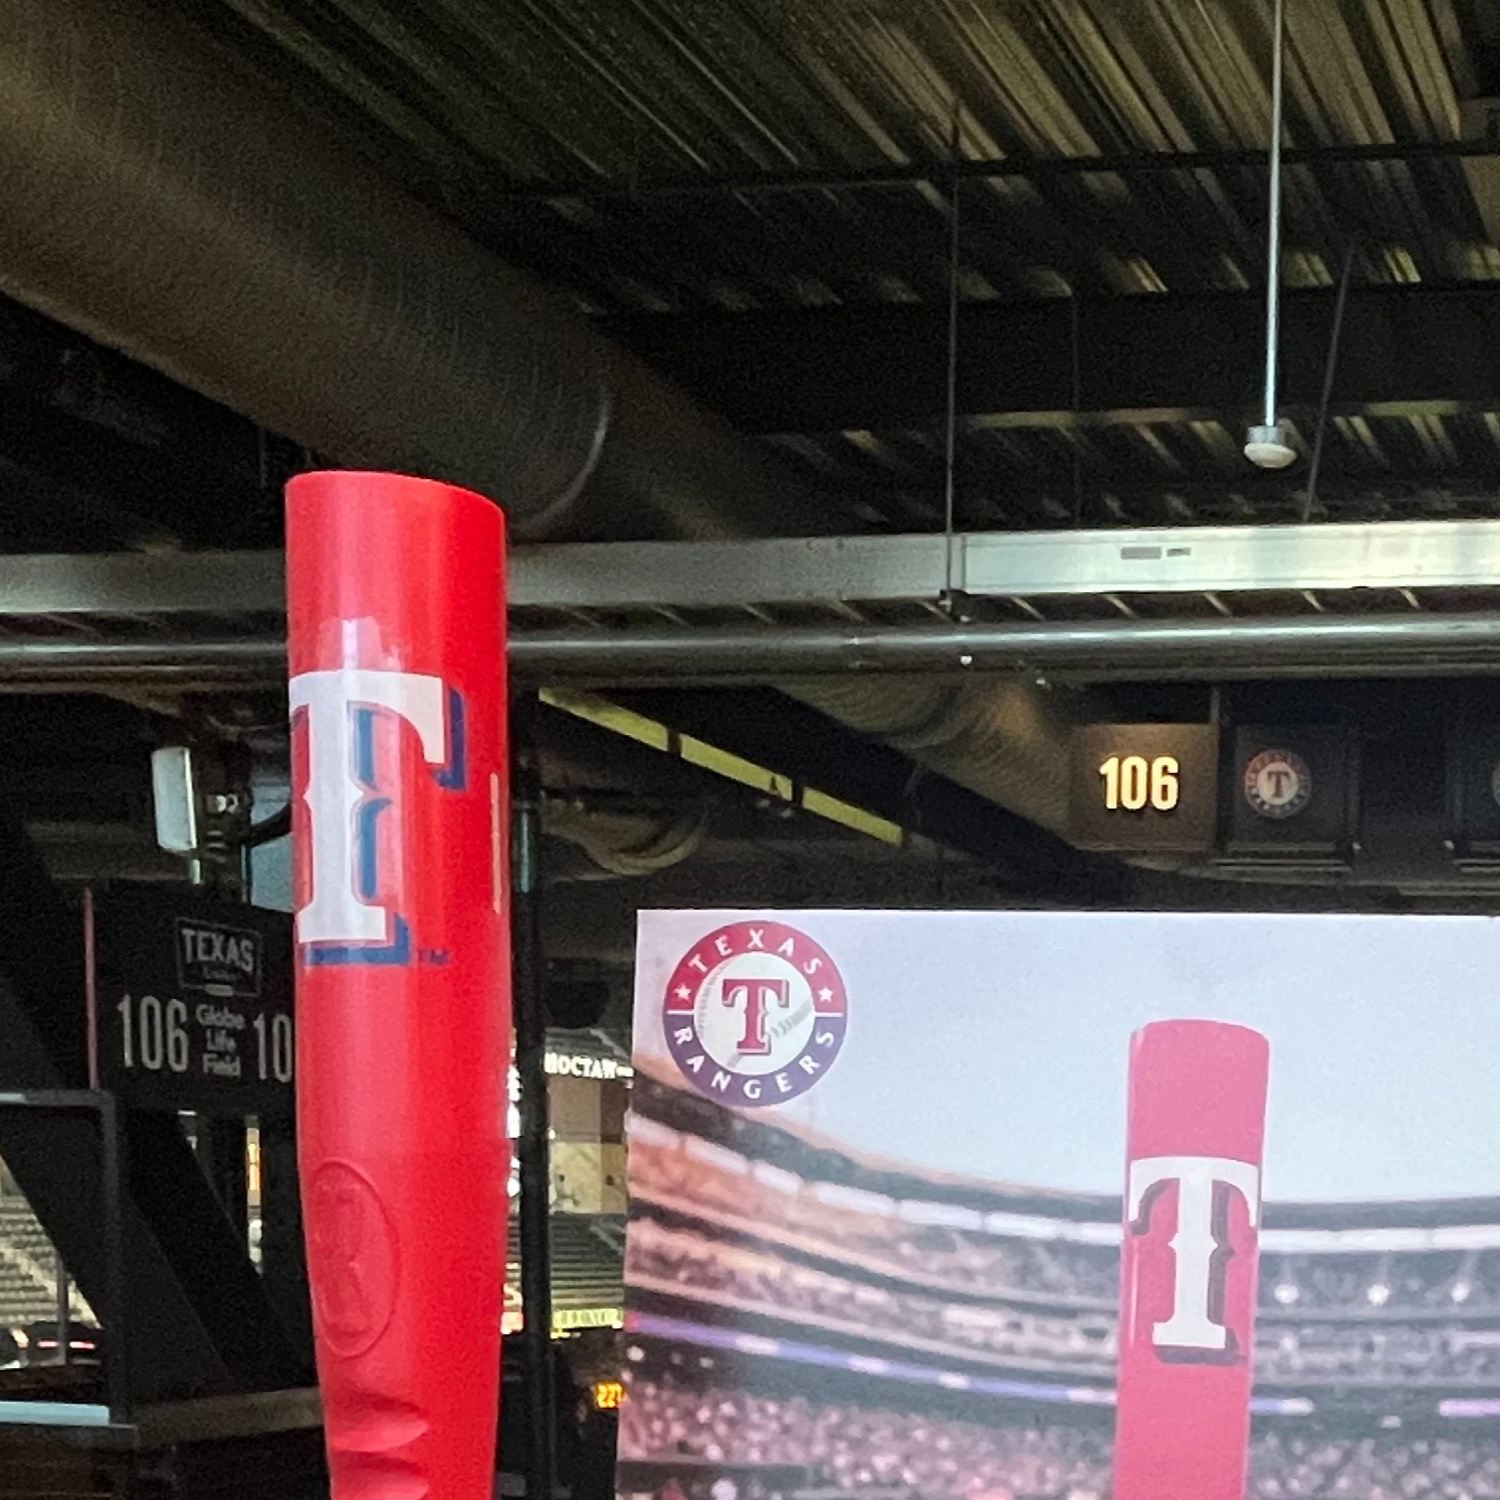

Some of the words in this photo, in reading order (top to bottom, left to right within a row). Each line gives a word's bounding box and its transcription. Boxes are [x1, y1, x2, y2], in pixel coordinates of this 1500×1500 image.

[1100, 756, 1179, 811] 106
[289, 669, 467, 966] T
[181, 928, 254, 973] TEXAS
[688, 928, 823, 975] TEXAS
[117, 993, 189, 1073] 106
[195, 1004, 246, 1030] Globe
[206, 1028, 237, 1052] Life
[721, 977, 790, 1057] T
[202, 1053, 241, 1077] Field
[674, 1025, 835, 1100] RANGERS
[1128, 1155, 1259, 1366] T
